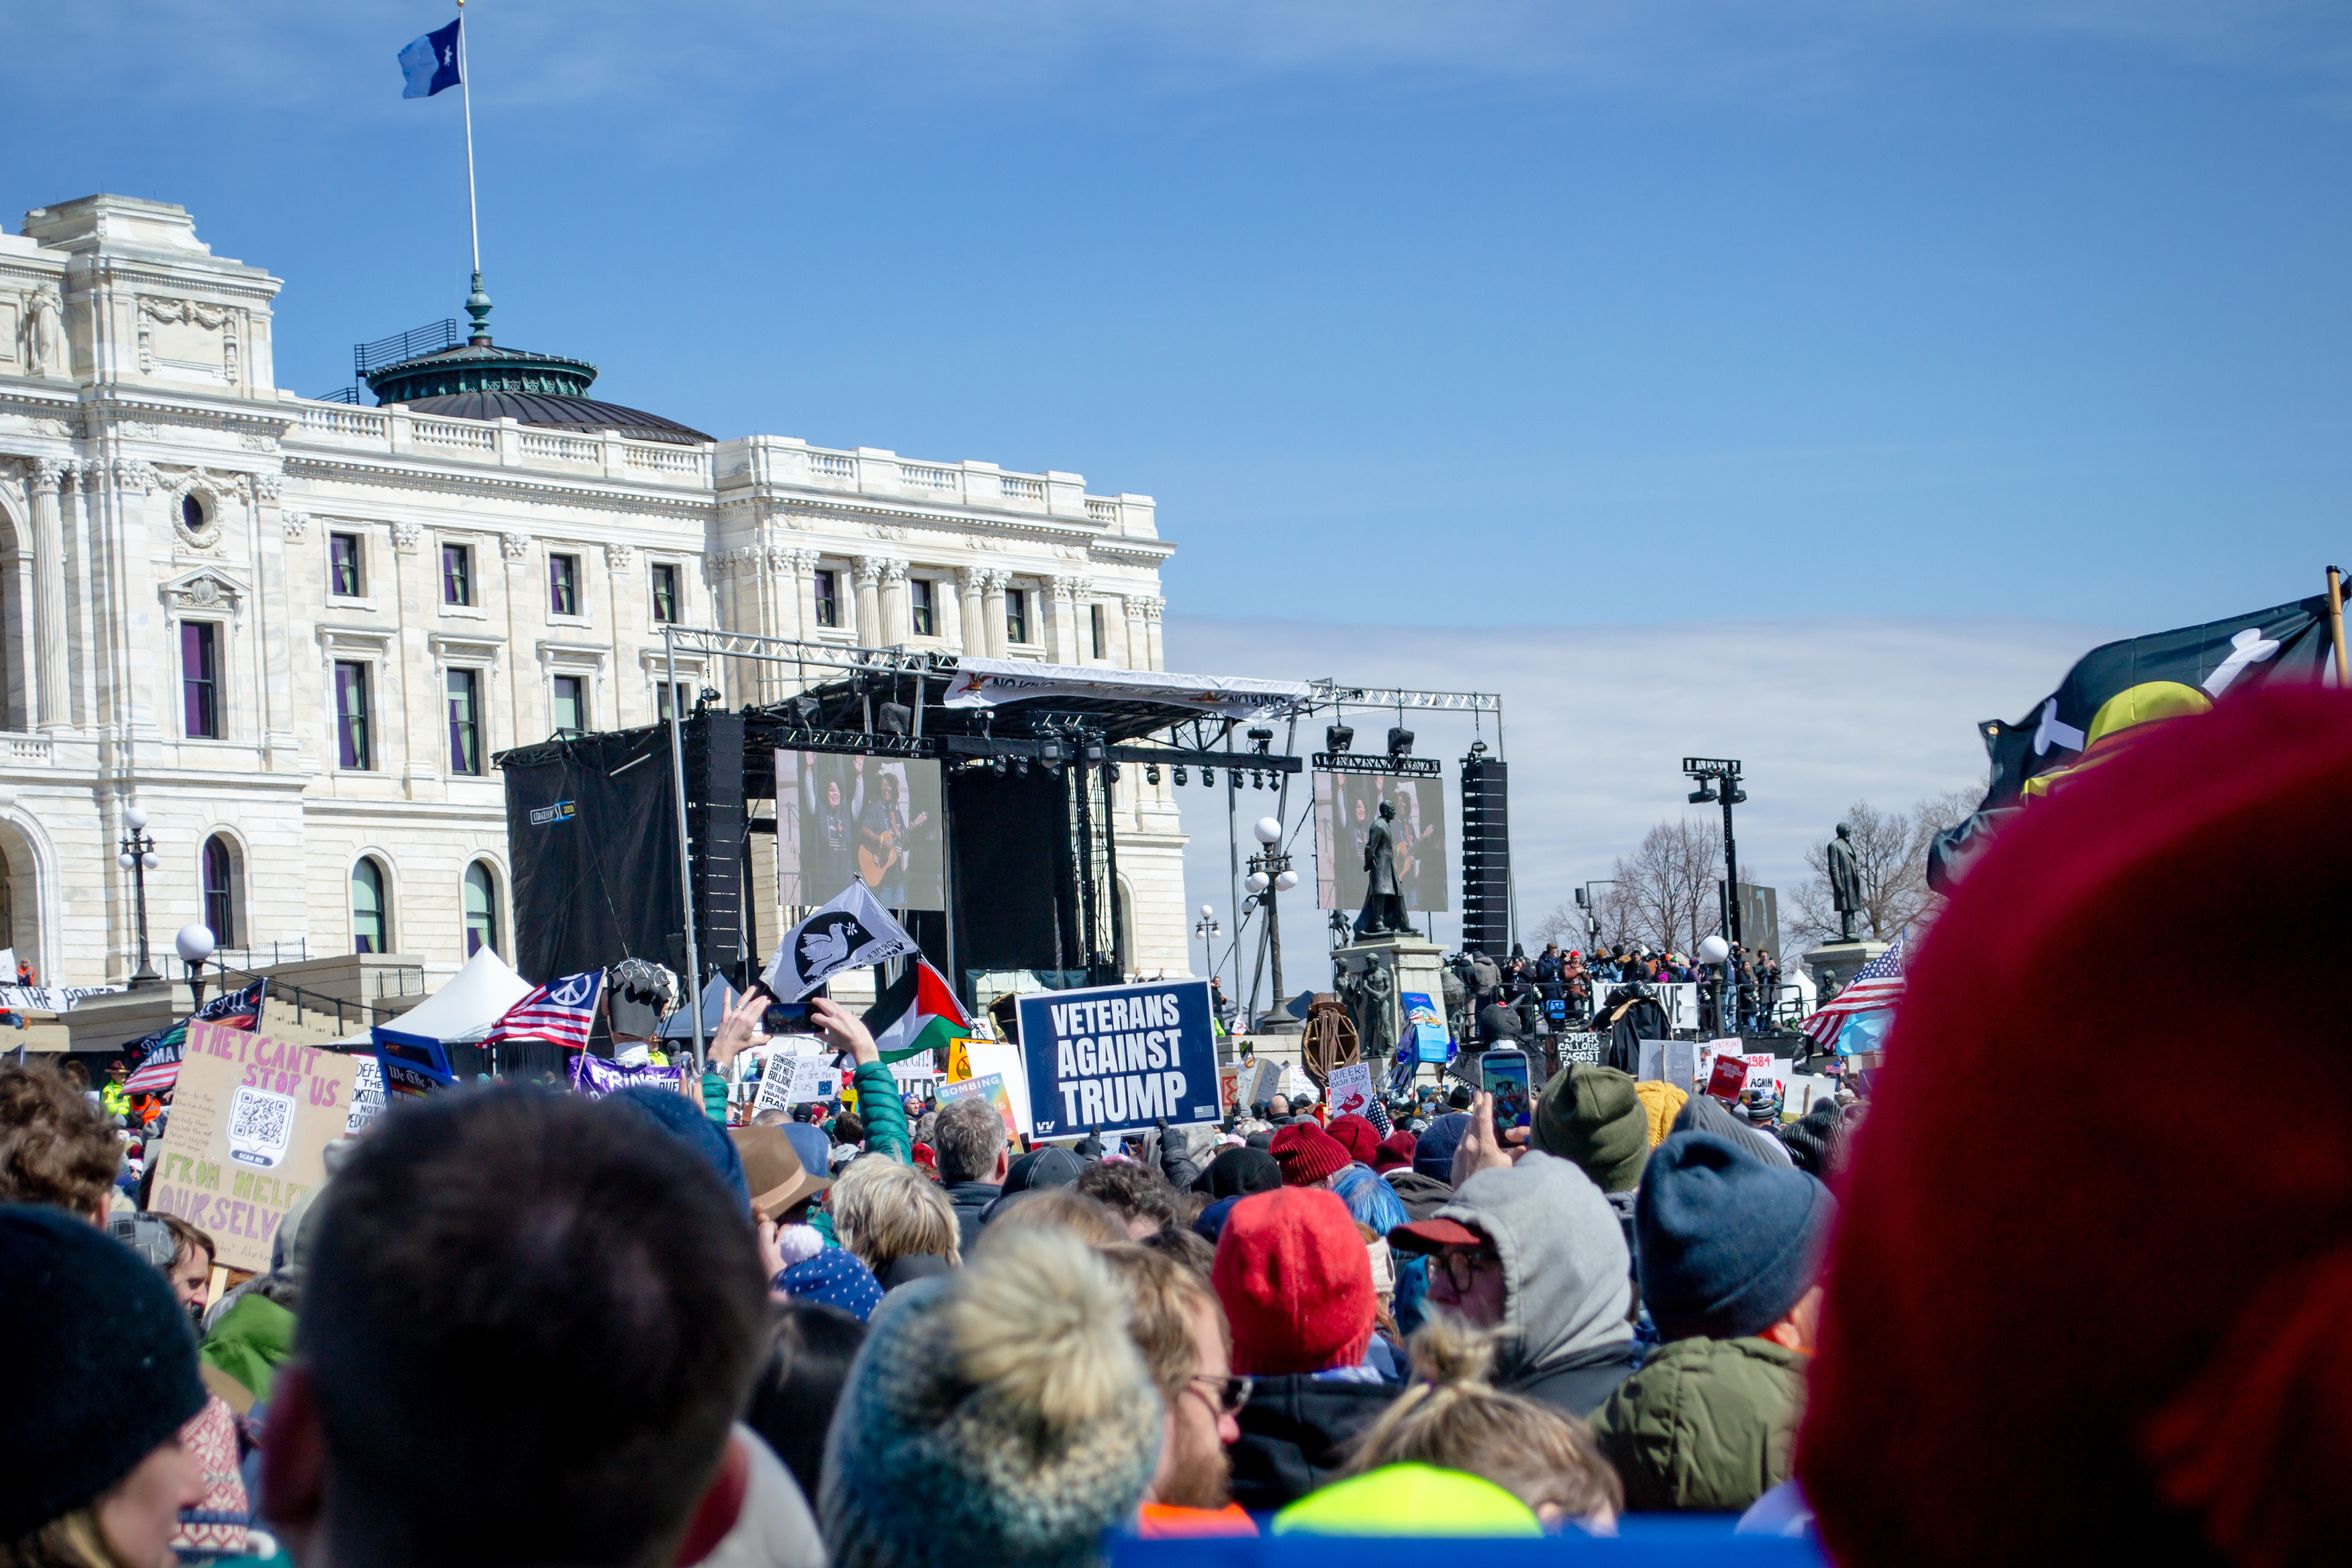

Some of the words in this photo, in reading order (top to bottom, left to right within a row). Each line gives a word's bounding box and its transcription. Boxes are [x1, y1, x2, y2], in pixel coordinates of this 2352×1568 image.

[17, 987, 56, 1010] THE
[1051, 993, 1180, 1036] VETERANS
[190, 1022, 252, 1062] THEY
[1564, 1032, 1600, 1043] SUPER
[1711, 1038, 1742, 1050] UNTRUMP
[1058, 1028, 1182, 1078] AGAINST
[1558, 1042, 1599, 1051] CALLOUS
[773, 1054, 796, 1070] CONGRESS
[888, 1049, 930, 1068] NOUGH!
[1559, 1051, 1600, 1061] FASCIST
[1746, 1055, 1771, 1068] 1984
[356, 1063, 381, 1079] DEFE
[771, 1063, 783, 1073] SAY
[783, 1066, 789, 1076] NO
[789, 1069, 794, 1078] TO
[799, 1061, 815, 1072] very
[1329, 1064, 1366, 1081] QUEERS
[242, 1063, 301, 1096] STOP
[363, 1079, 383, 1089] THE
[388, 1065, 404, 1081] We
[405, 1069, 425, 1087] The
[767, 1070, 792, 1088] BILLIONS
[1331, 1079, 1348, 1088] BASH
[1351, 1072, 1367, 1083] BACK
[1750, 1077, 1773, 1088] AGAIN
[764, 1089, 779, 1099] WAR
[765, 1082, 774, 1091] FOR
[941, 1076, 1000, 1098] BOMBING
[761, 1095, 785, 1110] IRAN
[1058, 1071, 1187, 1126] TRUMP
[360, 1105, 379, 1114] NOT
[238, 1152, 254, 1163] SCAN
[157, 1184, 285, 1242] OURSELV
